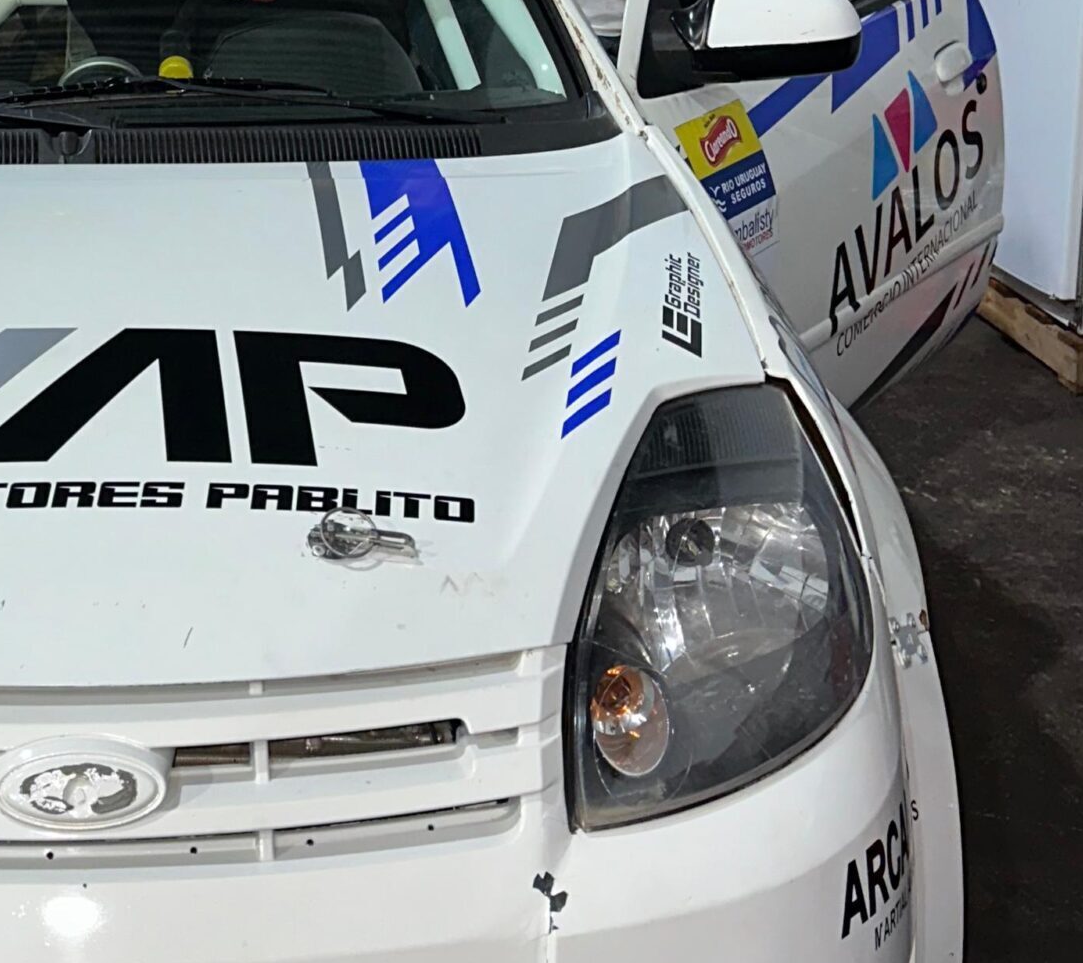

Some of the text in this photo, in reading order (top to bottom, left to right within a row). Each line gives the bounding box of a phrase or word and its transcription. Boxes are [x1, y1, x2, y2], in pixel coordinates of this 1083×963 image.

[720, 162, 767, 194] RIO URUGUAY
[730, 178, 767, 205] SEGUROS
[734, 208, 775, 241] mbalisty
[829, 99, 984, 337] AVALOS
[664, 253, 686, 310] Graphic
[683, 251, 704, 319] Designer
[836, 190, 978, 357] COMERCIO INTERNACIONAL
[205, 482, 476, 524] PABLITO
